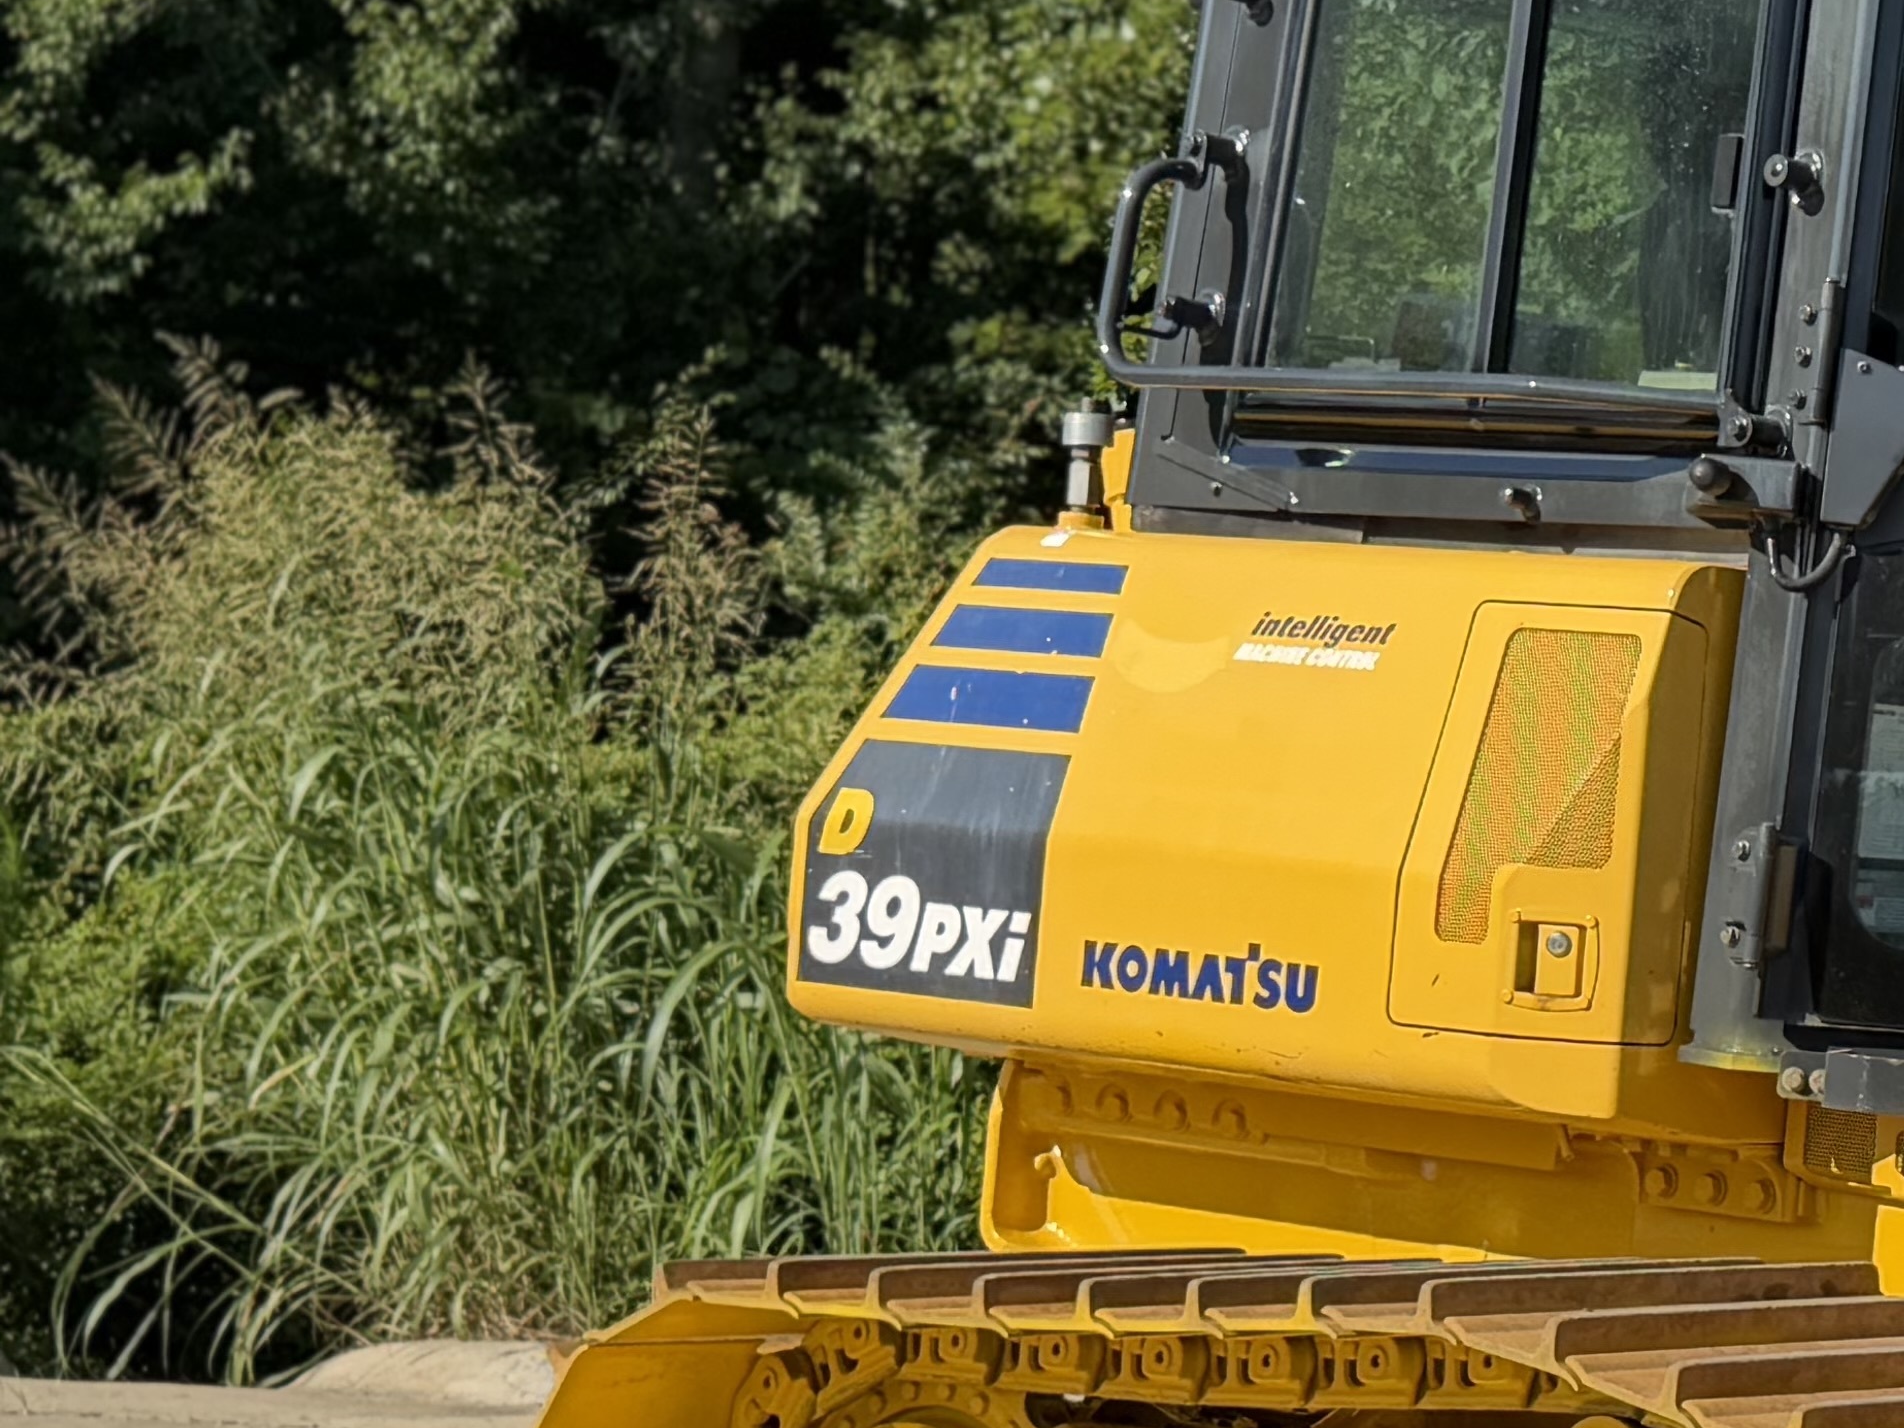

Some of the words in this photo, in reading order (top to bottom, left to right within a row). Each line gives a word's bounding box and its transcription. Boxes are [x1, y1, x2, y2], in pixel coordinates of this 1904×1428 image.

[1251, 611, 1397, 648] intelligent
[817, 787, 875, 855] D
[807, 870, 1032, 982] 39PXi
[1081, 939, 1320, 1013] KOMATSU
